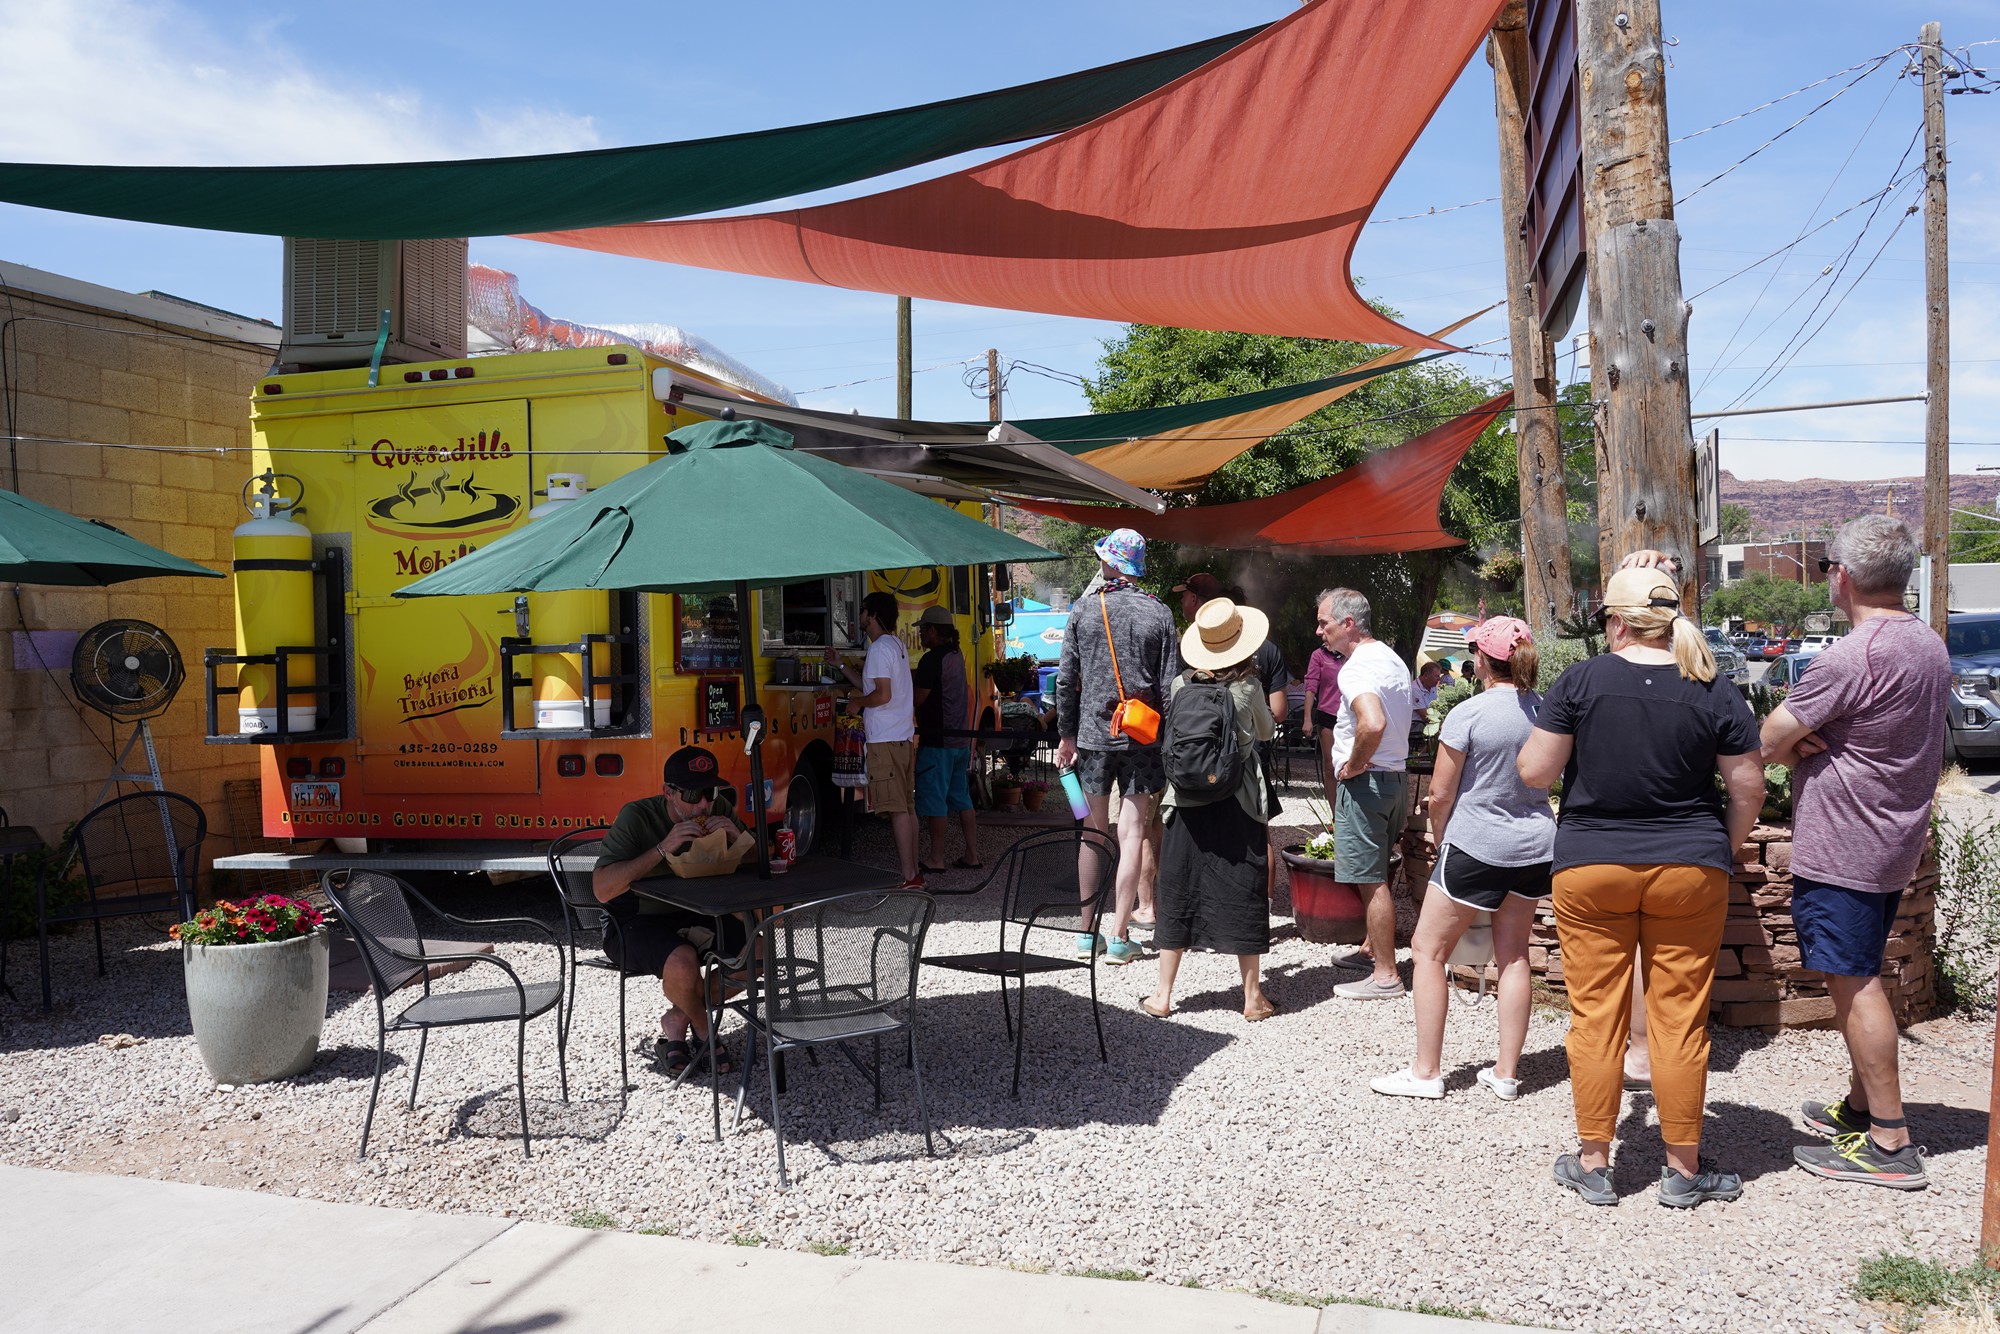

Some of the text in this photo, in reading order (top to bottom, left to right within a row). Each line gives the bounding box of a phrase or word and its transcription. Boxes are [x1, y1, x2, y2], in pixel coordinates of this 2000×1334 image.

[370, 428, 513, 469] Quesadilla
[403, 666, 460, 693] Beyond
[397, 676, 495, 714] Traditional
[709, 684, 723, 699] Open
[398, 743, 498, 753] 435-260-0289
[294, 792, 336, 806] Y51 9HY
[281, 811, 613, 828] DELICIOUS GOURMET QUESADILL
